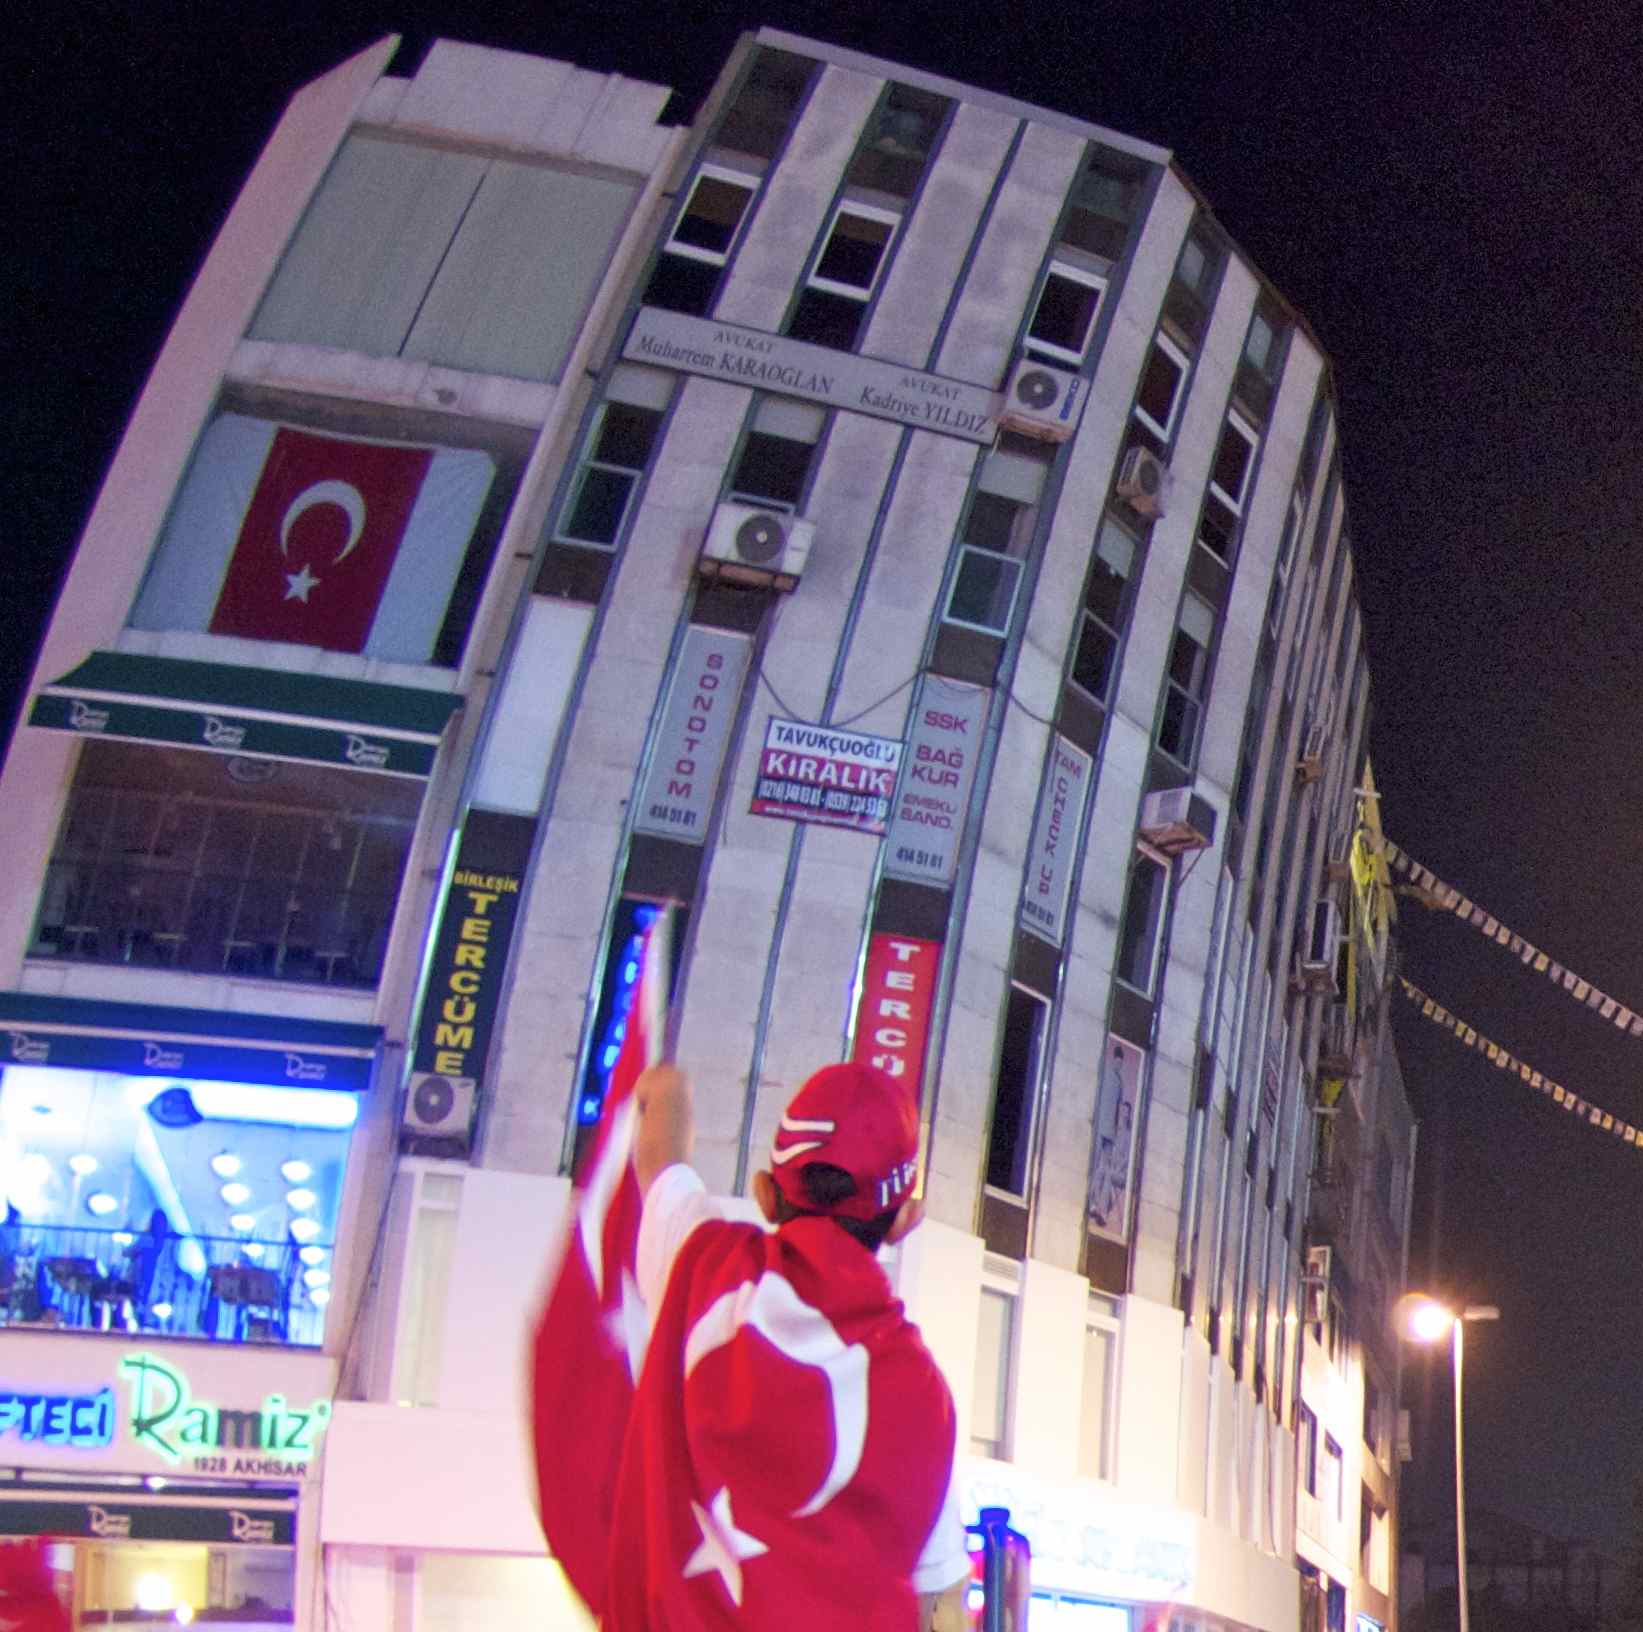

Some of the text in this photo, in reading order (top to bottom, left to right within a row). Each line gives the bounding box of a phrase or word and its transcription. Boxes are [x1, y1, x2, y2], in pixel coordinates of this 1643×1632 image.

[639, 335, 714, 369] Muharrem
[713, 330, 773, 353] AVUKAT
[900, 376, 960, 400] AVUKAT
[860, 386, 991, 435] Kadriye YILDIZ
[923, 709, 969, 734] SSK
[775, 726, 896, 763] TAVUKÇUOĞLU
[916, 743, 965, 769] BAĞ
[766, 752, 890, 794] KIRALIK
[911, 764, 960, 788] KUR
[453, 869, 520, 894] BİRLEŞİK
[433, 890, 499, 1076] TERCÜME
[121, 1348, 312, 1458] Ramiz
[193, 1456, 308, 1478] 1928 AKHİSAR
